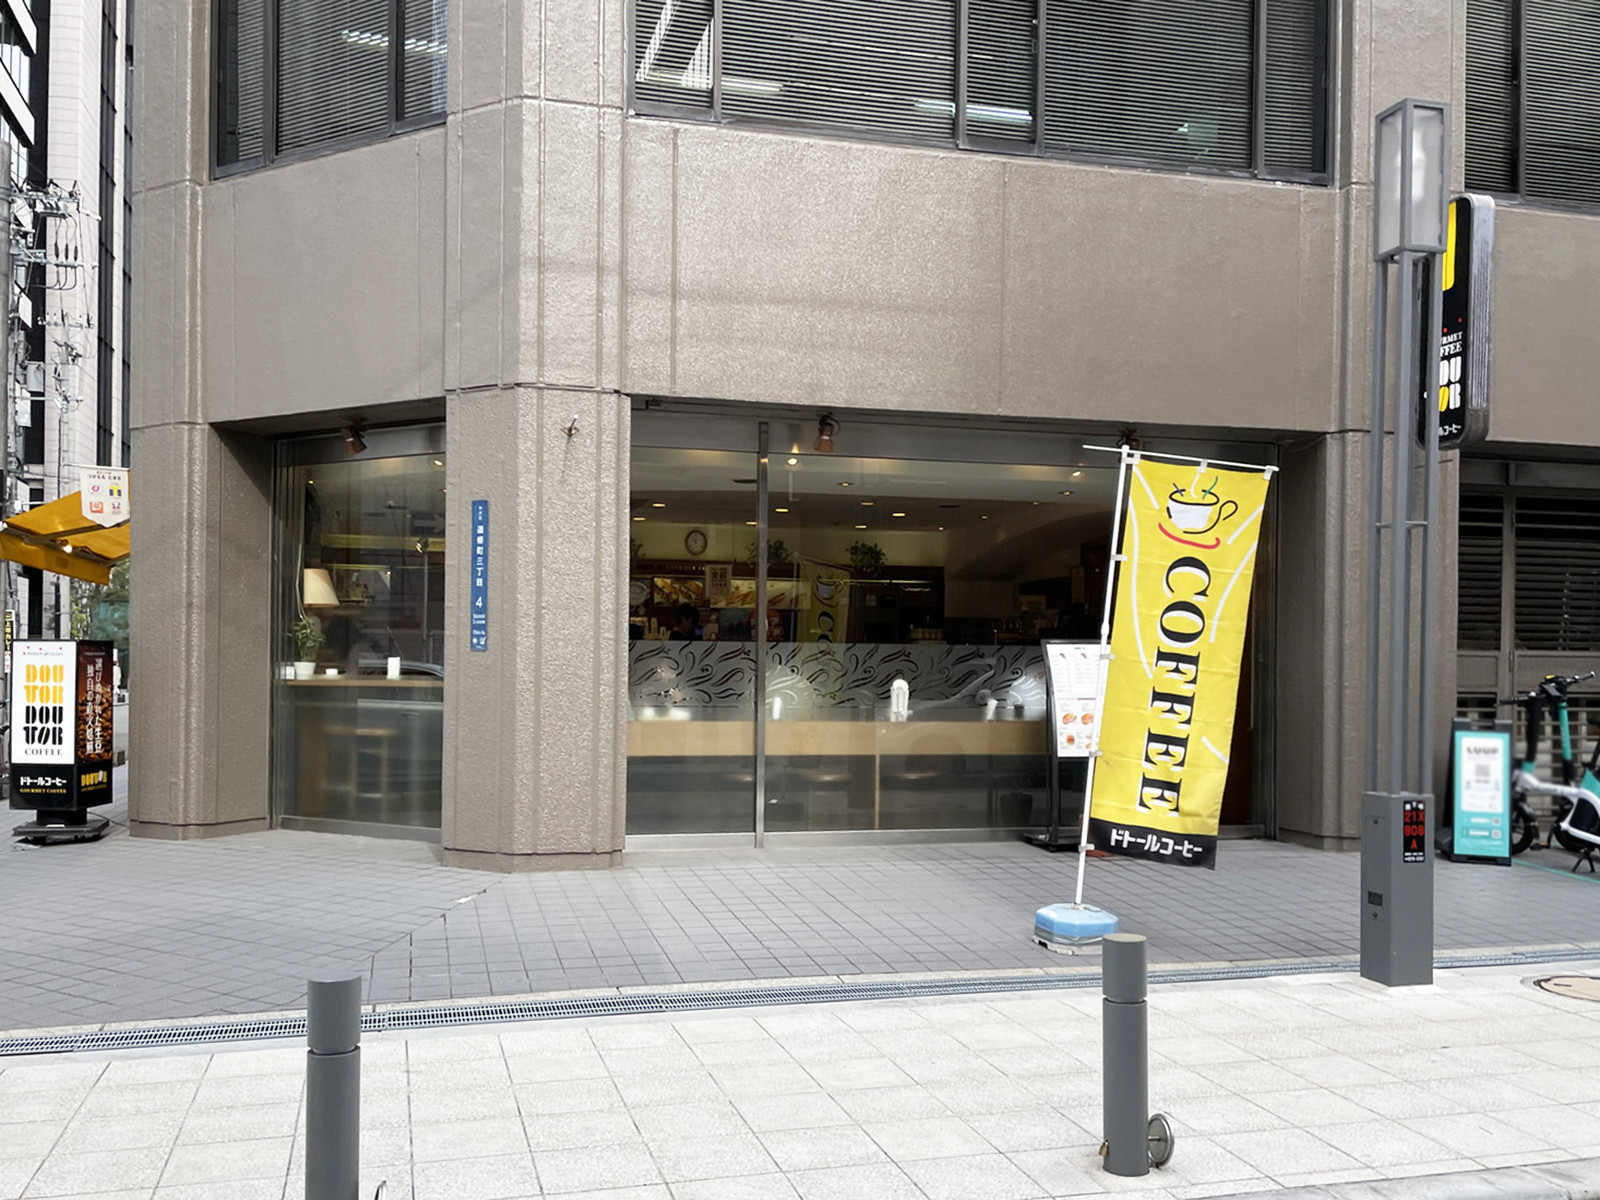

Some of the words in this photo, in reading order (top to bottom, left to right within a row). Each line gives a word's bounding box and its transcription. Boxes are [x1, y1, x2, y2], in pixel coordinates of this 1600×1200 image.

[1441, 331, 1463, 345] RMET
[1440, 341, 1463, 357] FFEE
[475, 596, 483, 608] 4
[25, 664, 64, 684] DOU
[1137, 556, 1211, 815] COFFEE
[25, 705, 64, 725] DOU
[23, 726, 63, 745] TOR
[24, 748, 63, 756] COFFEE
[20, 776, 67, 786] ドトールコーヒー
[1110, 828, 1203, 857] ドトールコーヒー
[1411, 838, 1418, 849] A
